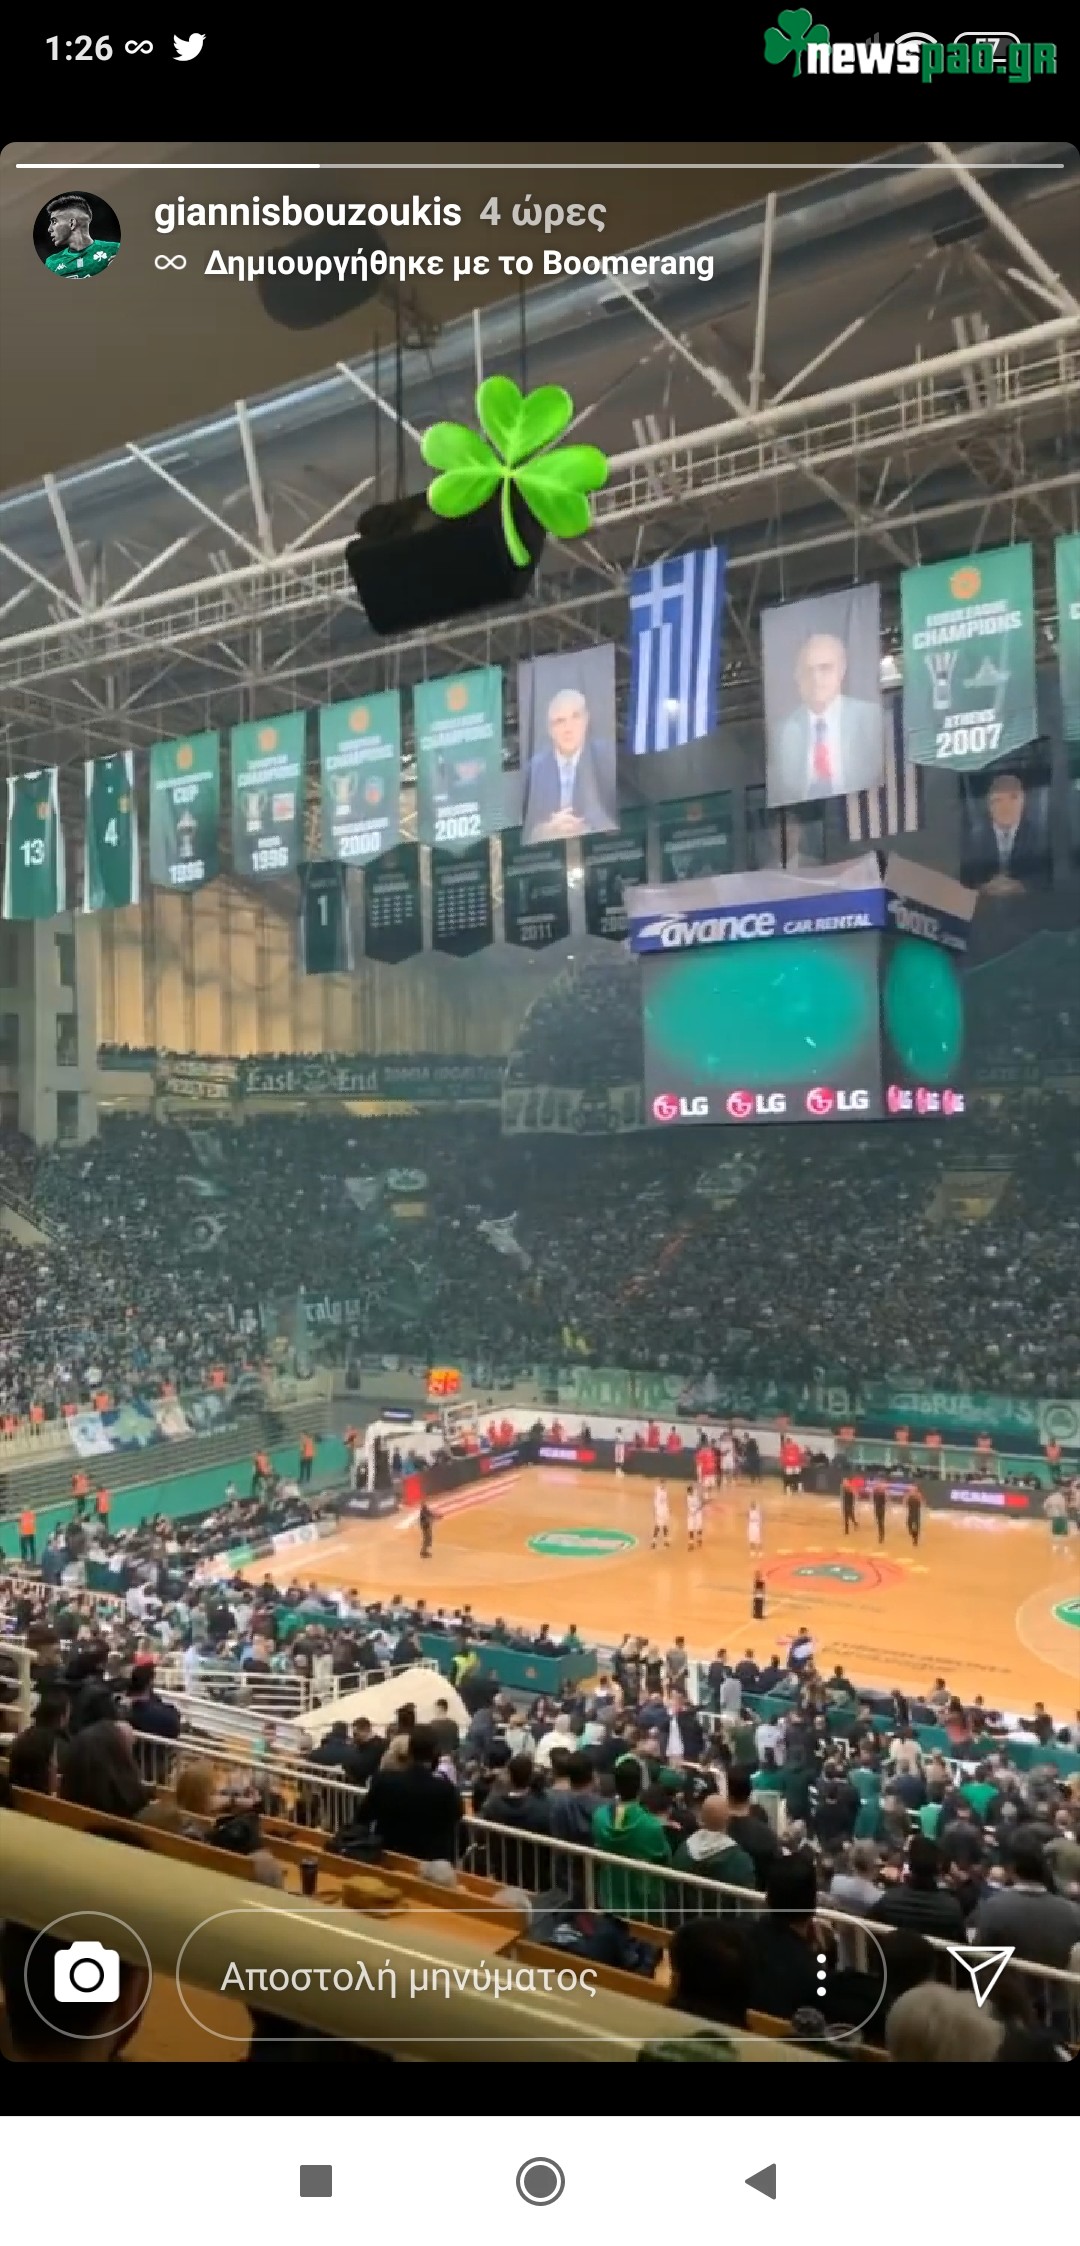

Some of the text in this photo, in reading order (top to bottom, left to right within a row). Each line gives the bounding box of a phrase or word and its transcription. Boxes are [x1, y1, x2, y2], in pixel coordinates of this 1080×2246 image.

[912, 610, 1023, 650] CHAMPIONS
[936, 723, 1004, 758] 2007
[104, 817, 118, 847] 4
[435, 813, 481, 842] 2002
[20, 838, 46, 868] 13
[339, 831, 382, 859] 2000
[317, 895, 328, 927] 1
[660, 912, 776, 947] avance
[815, 913, 873, 932] RENTAL
[681, 1096, 709, 1117] LG
[756, 1092, 787, 1114] LG
[837, 1089, 870, 1112] LG
